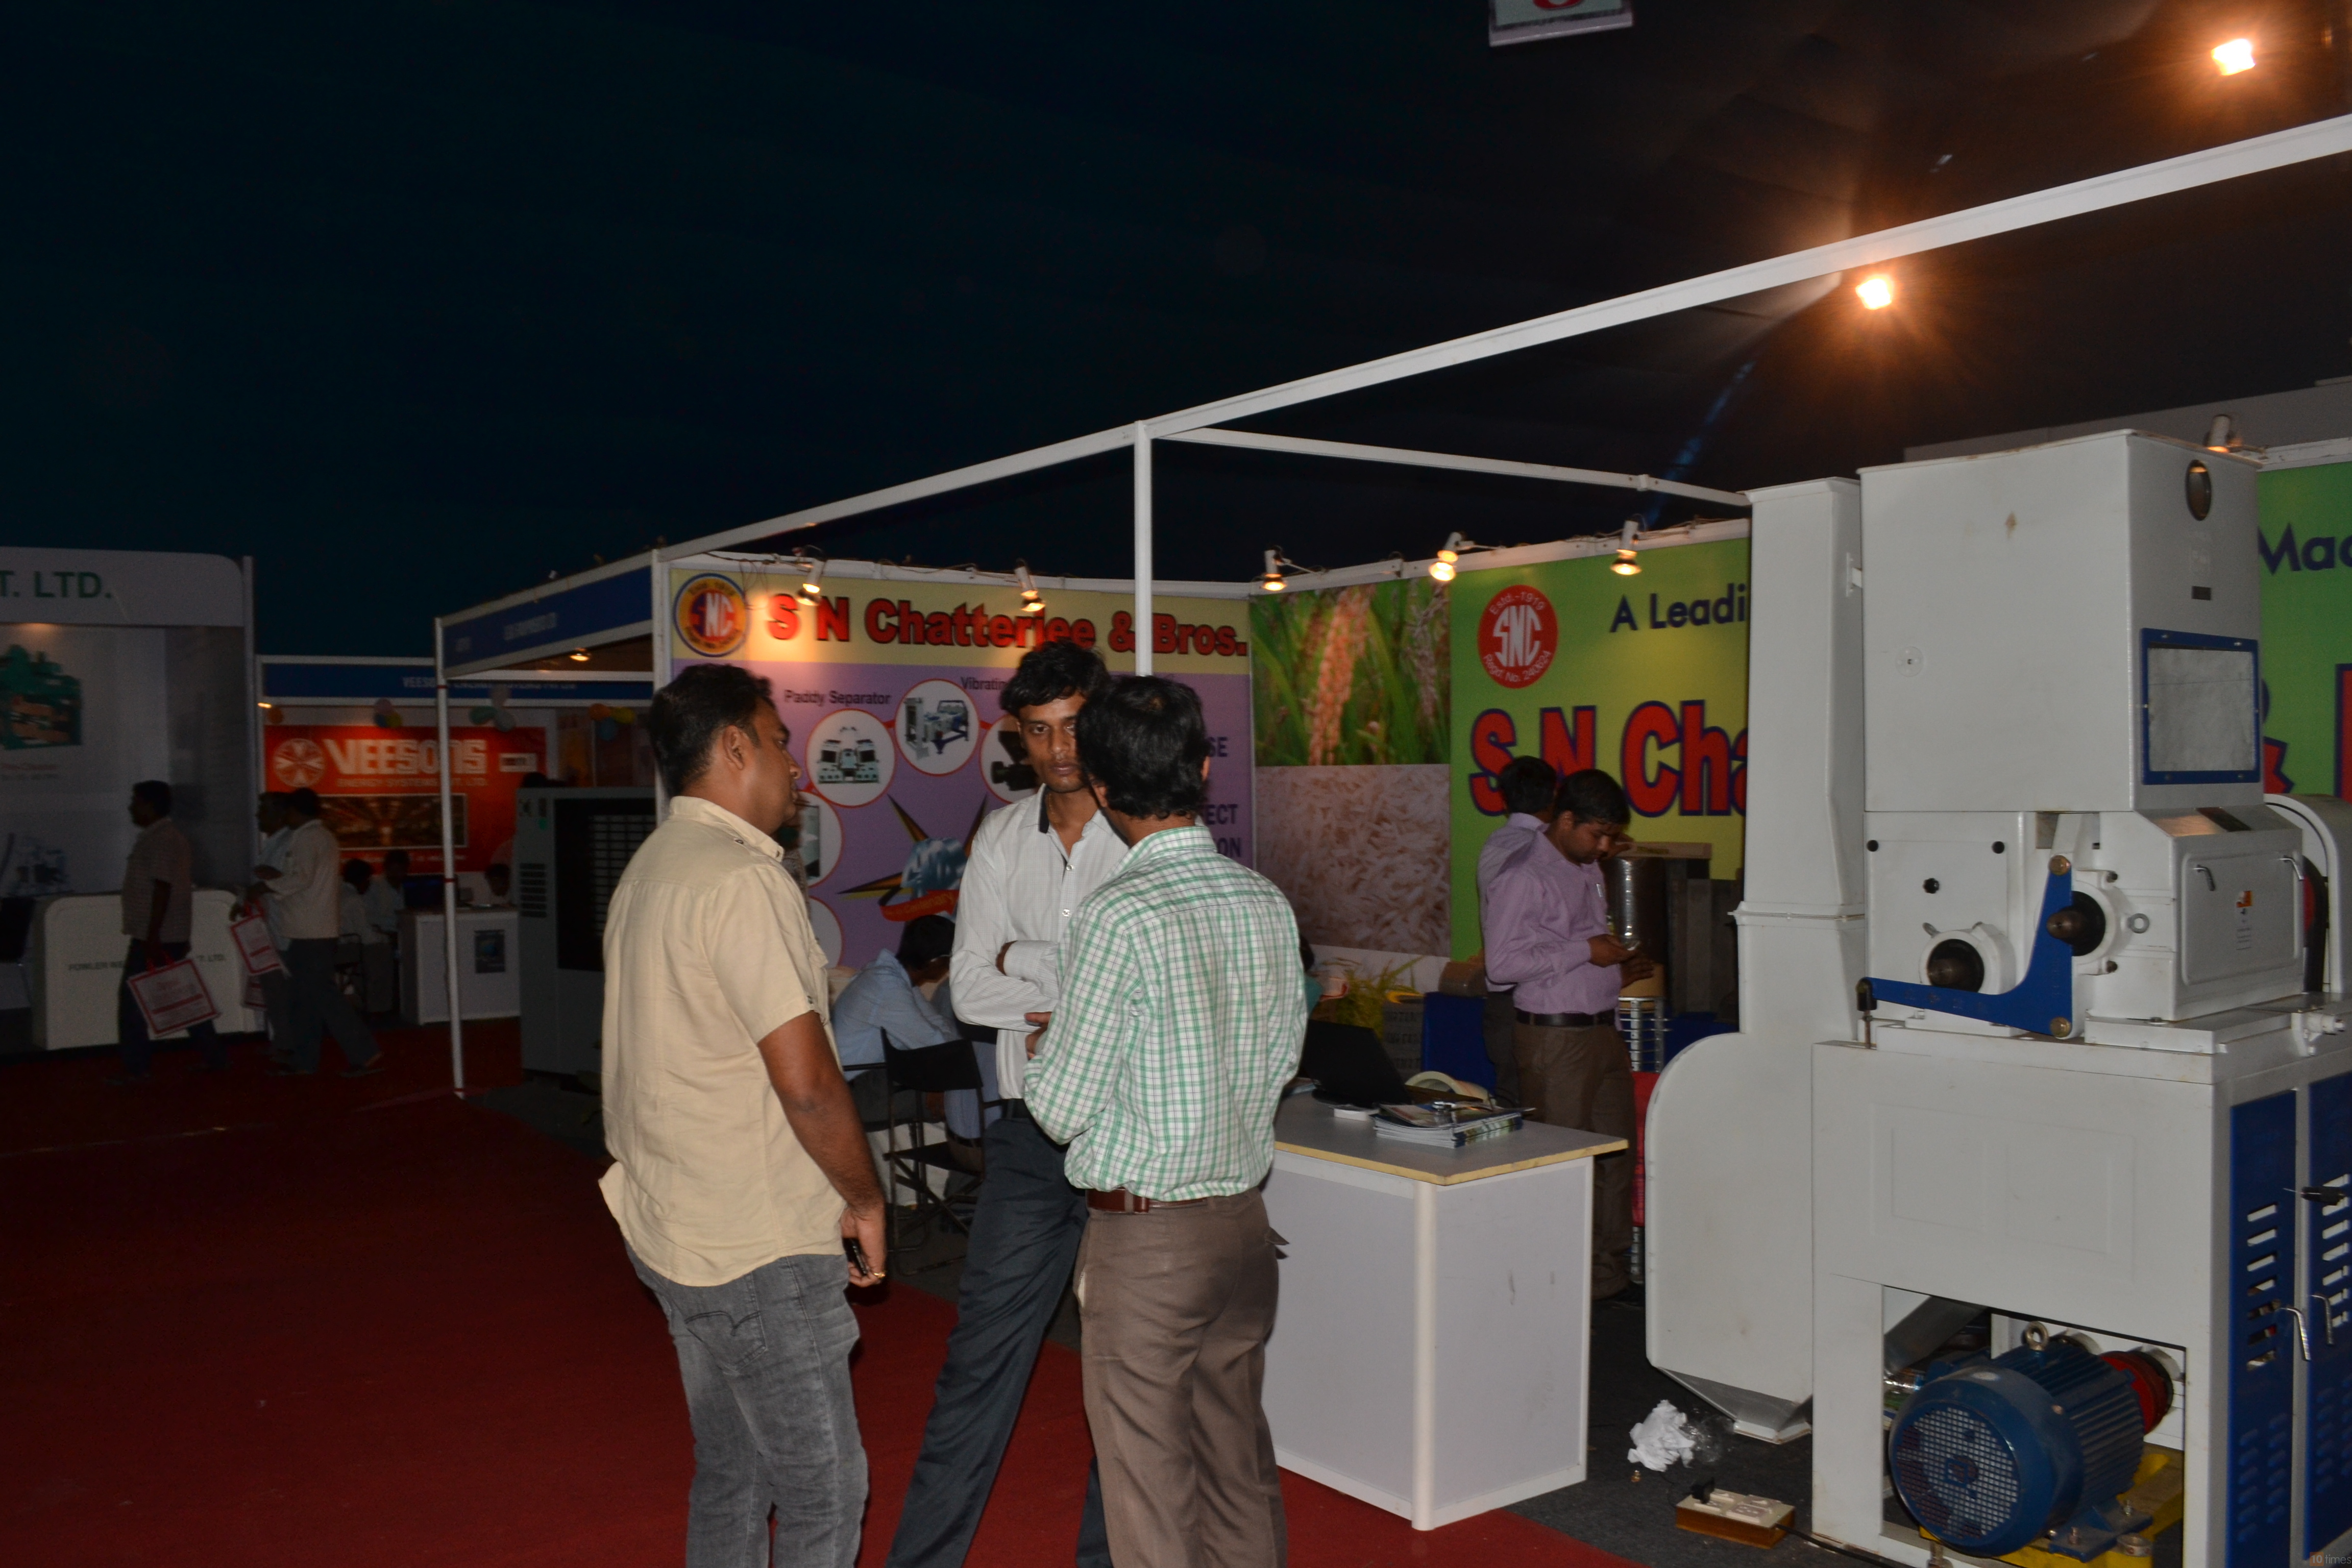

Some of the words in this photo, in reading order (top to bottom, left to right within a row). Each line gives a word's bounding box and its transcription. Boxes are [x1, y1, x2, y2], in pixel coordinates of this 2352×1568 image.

[34, 571, 111, 598] LTD.
[767, 594, 799, 640] S
[817, 596, 849, 642] N
[865, 598, 1096, 652] Chatterjee
[1108, 611, 1136, 653] &
[1152, 613, 1247, 656] Bros.
[1609, 595, 1637, 632] A
[1650, 583, 1747, 629] Leadi
[1493, 604, 1543, 667] SNC
[785, 690, 825, 705] Paddy
[829, 690, 891, 705] Separator
[961, 676, 1007, 690] Vibratin
[1468, 708, 1516, 816] S
[1540, 705, 1596, 789] N
[1202, 803, 1237, 825] ECT
